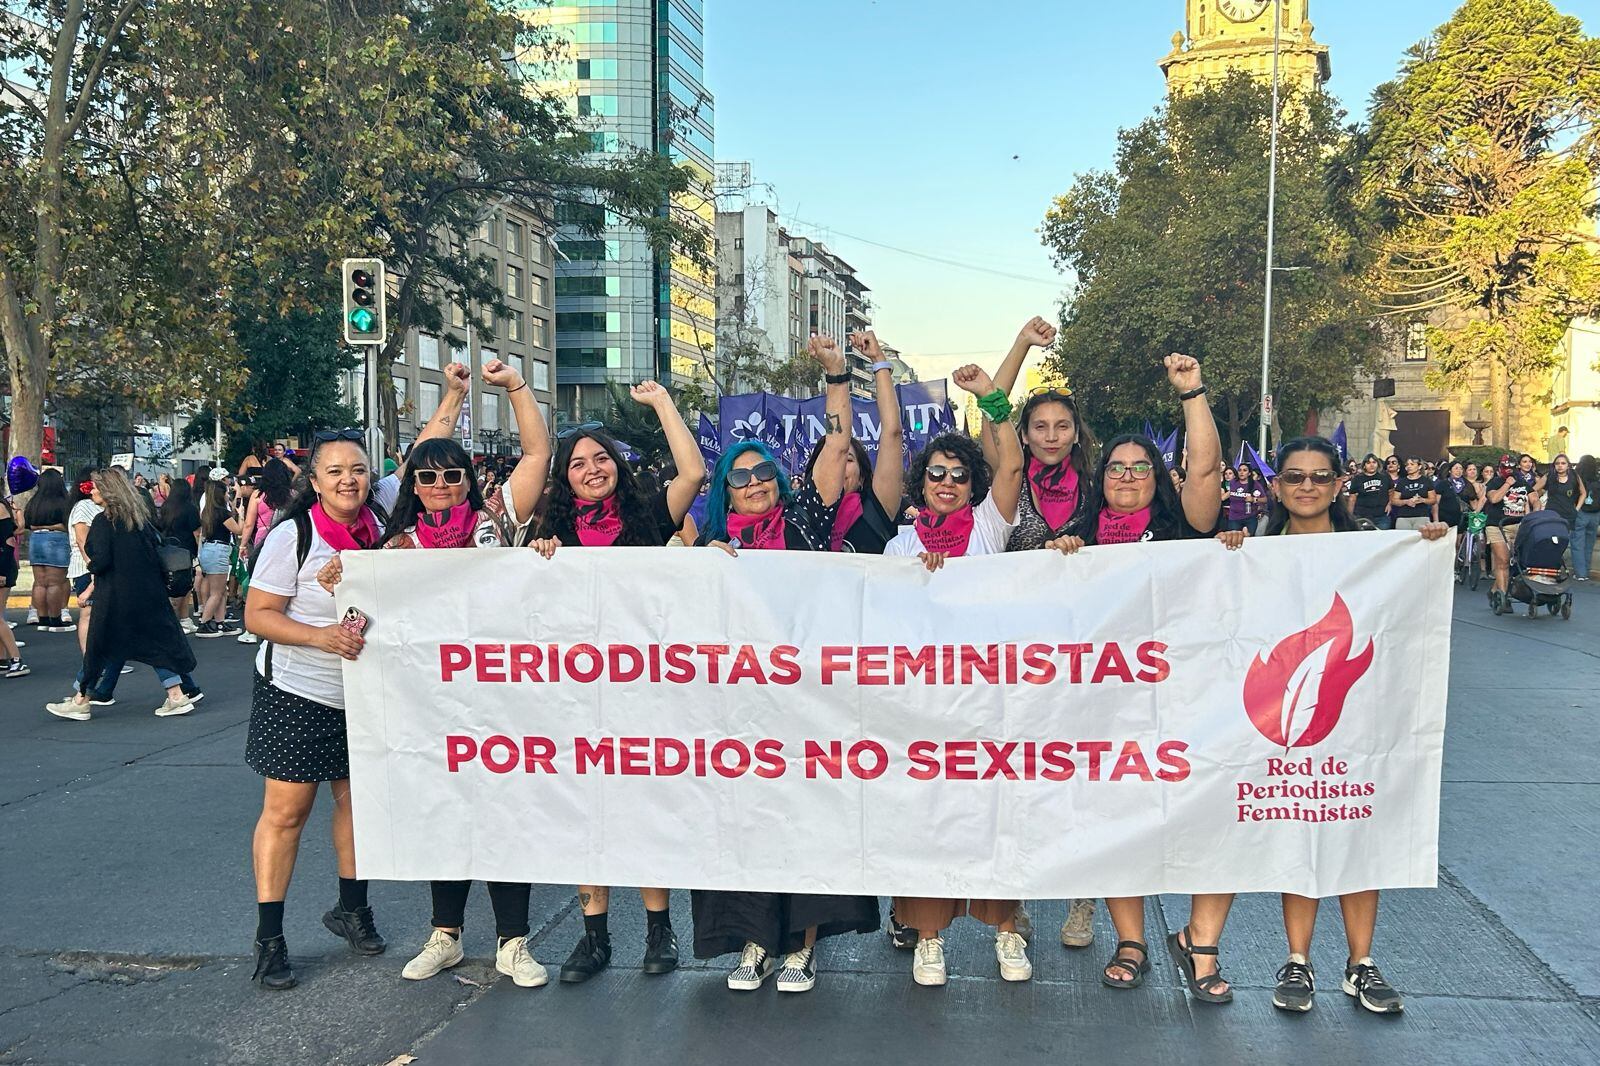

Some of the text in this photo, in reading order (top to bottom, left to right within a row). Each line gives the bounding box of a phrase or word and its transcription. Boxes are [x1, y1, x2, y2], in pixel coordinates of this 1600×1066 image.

[440, 641, 1171, 685] PERIODISTAS FEMINISTAS
[446, 735, 1191, 783] POR MEDIOS NO SEXISTAS
[1266, 756, 1348, 776] Red de
[1237, 780, 1375, 800] Periodistas
[1237, 802, 1373, 822] Feministas
